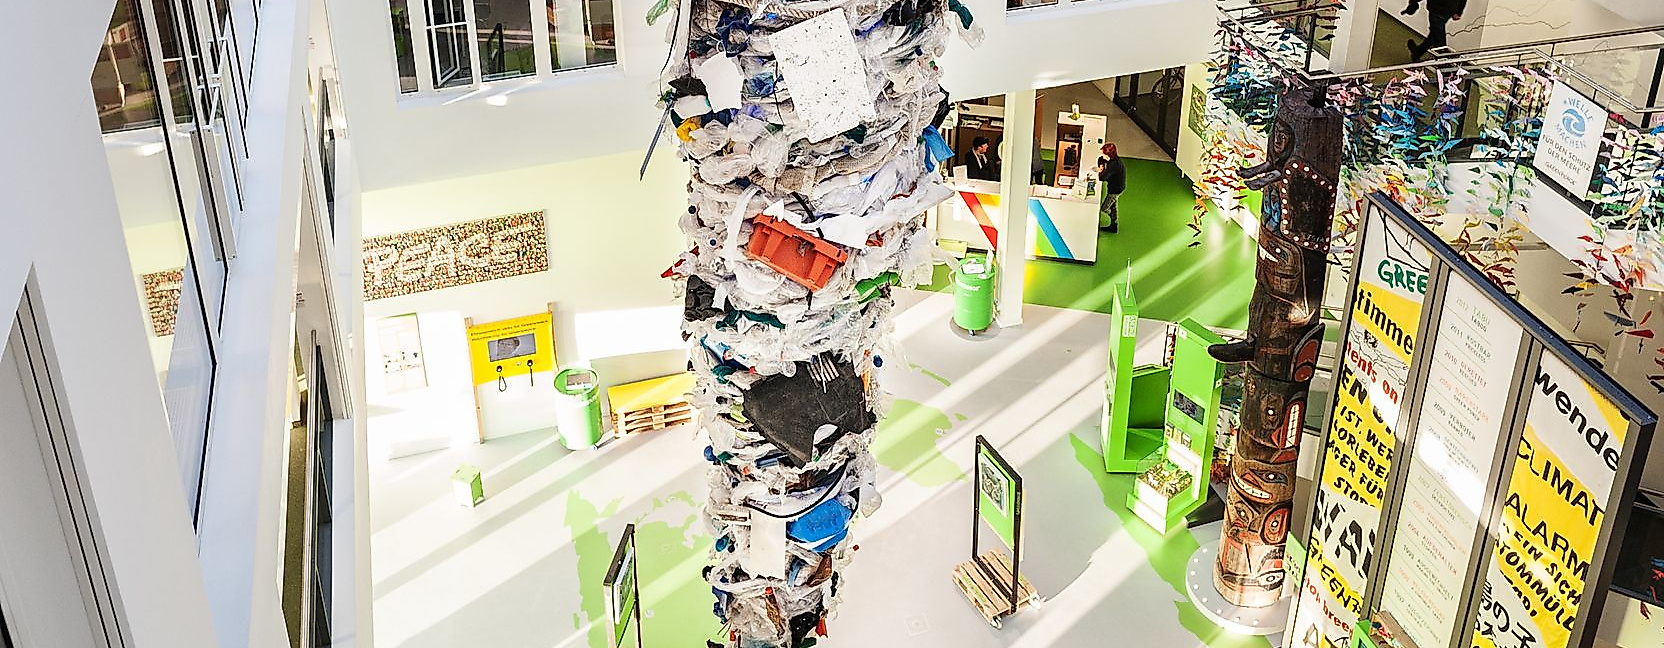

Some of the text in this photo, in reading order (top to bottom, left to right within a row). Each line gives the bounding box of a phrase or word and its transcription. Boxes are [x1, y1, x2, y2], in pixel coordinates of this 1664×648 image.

[1568, 97, 1594, 121] WELLE
[1382, 379, 1398, 405] on
[1535, 365, 1621, 472] wende
[1517, 434, 1605, 527] CLIMAT
[1504, 491, 1590, 581] ALARM
